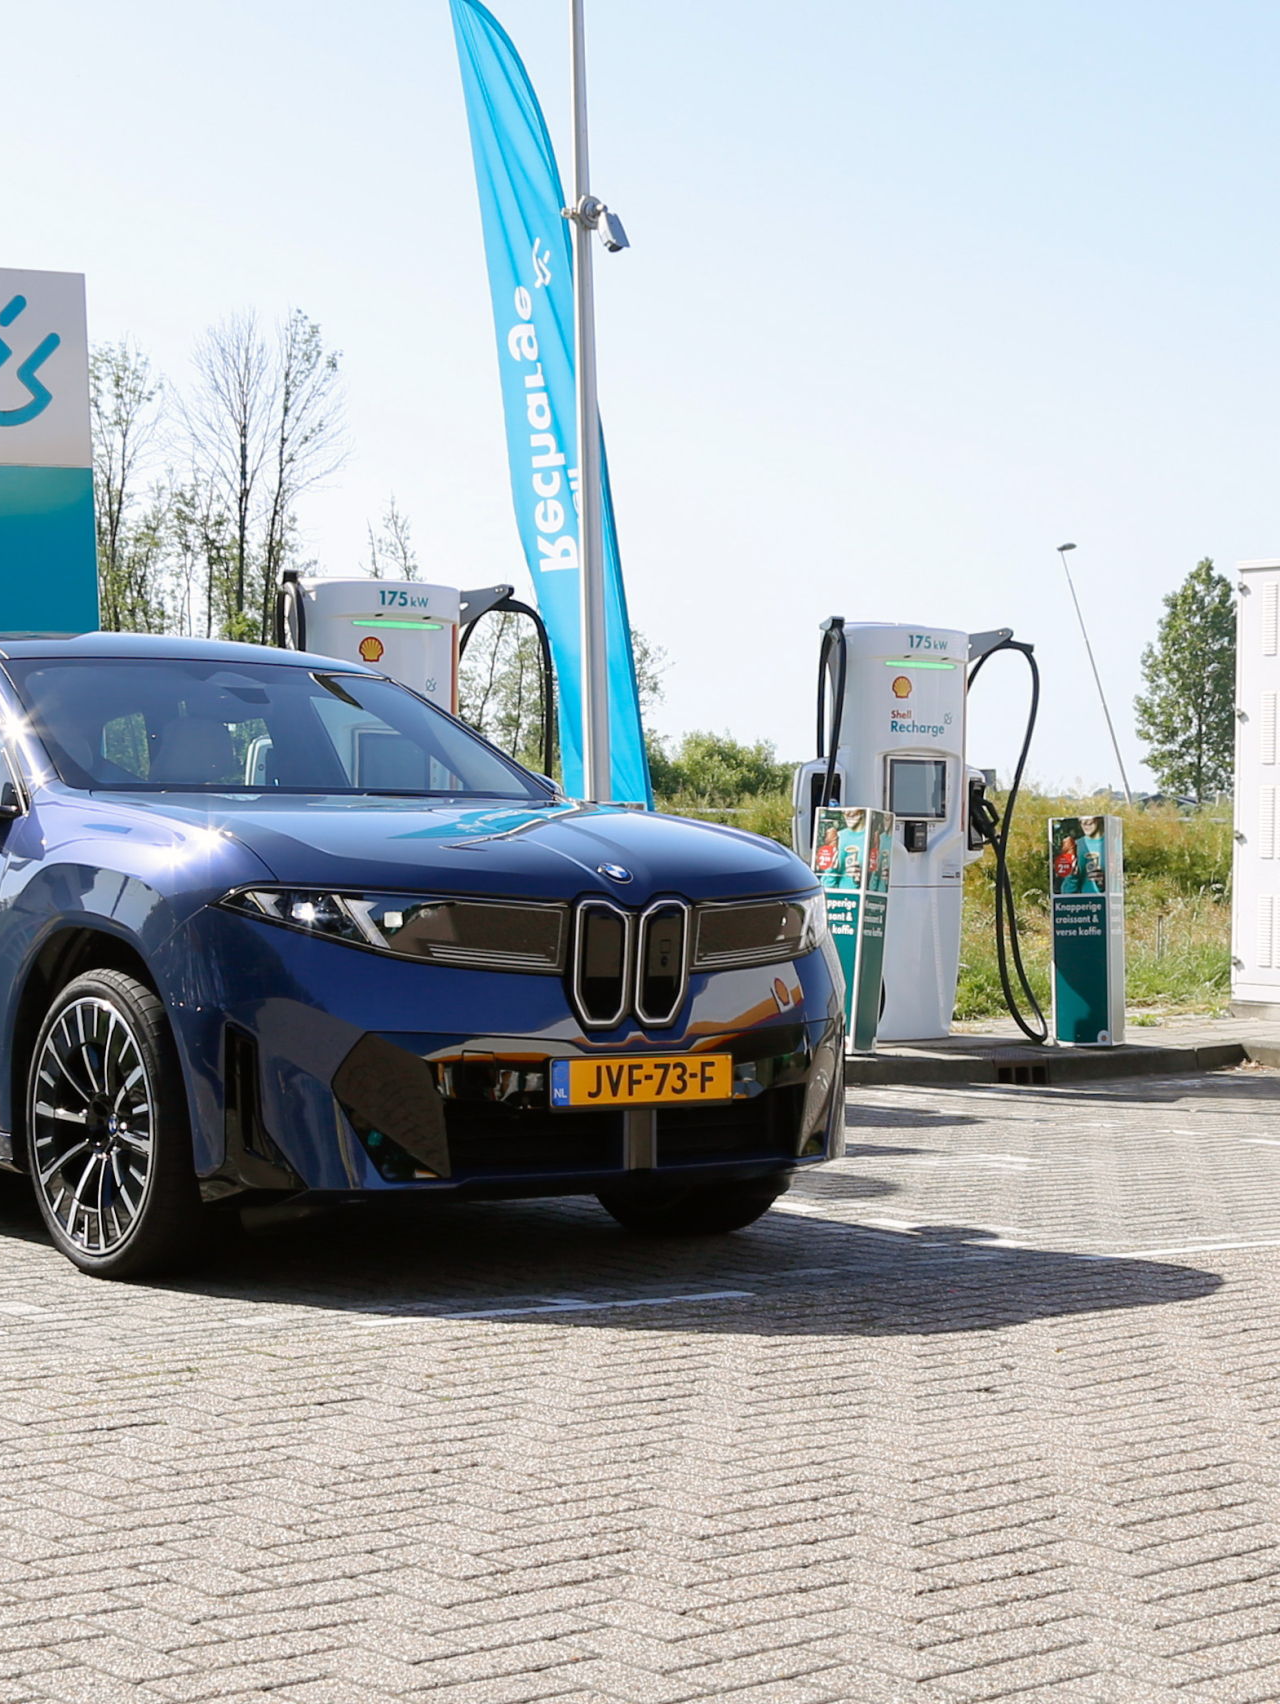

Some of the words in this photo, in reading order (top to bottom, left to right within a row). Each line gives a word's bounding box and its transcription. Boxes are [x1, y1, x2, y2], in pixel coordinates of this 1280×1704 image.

[380, 590, 408, 607] 175
[410, 596, 429, 608] kW
[908, 634, 932, 649] 175
[933, 641, 948, 651] kW
[891, 710, 912, 719] Shell
[891, 720, 945, 737] Recharge
[827, 898, 857, 910] pperige
[1055, 902, 1102, 913] Knapperige
[1055, 914, 1090, 924] croissant
[1092, 914, 1099, 923] &
[832, 924, 854, 935] koffie
[1055, 928, 1077, 936] verse
[1078, 926, 1102, 936] koffie
[587, 1061, 716, 1098] JVF-73-F
[554, 1088, 568, 1099] NL
